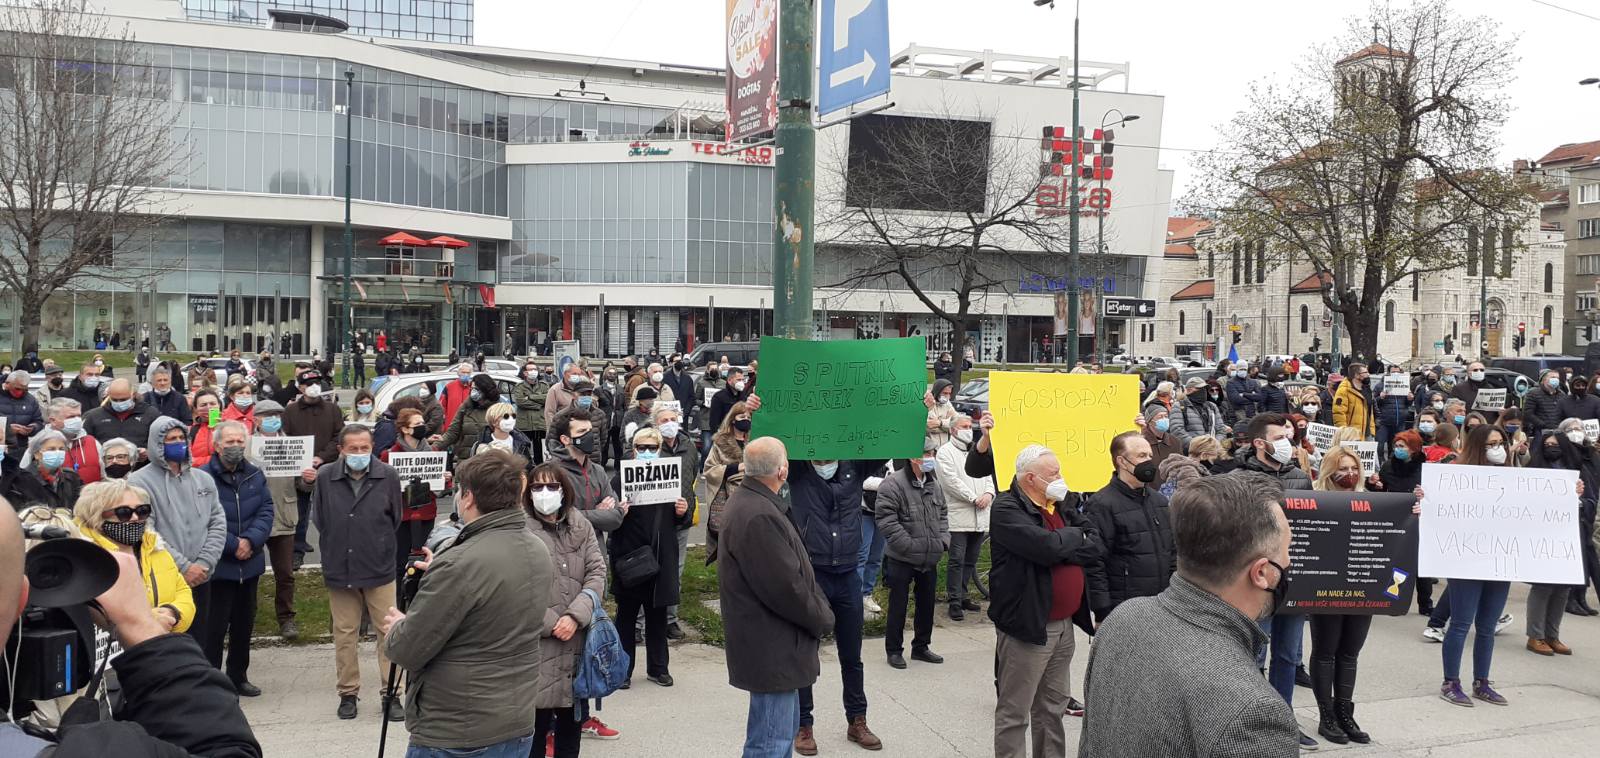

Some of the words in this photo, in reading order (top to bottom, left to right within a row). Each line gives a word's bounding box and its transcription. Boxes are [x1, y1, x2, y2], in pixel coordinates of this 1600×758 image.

[735, 30, 761, 62] SALE
[737, 79, 761, 99] DOĞTAŞ
[793, 359, 897, 387] SPUTNIK
[756, 387, 854, 412] MUBAREK
[865, 381, 927, 406] OLSUN
[392, 457, 413, 466] IDITE
[415, 456, 443, 466] ODMAH
[624, 462, 679, 484] DRŽAVA
[624, 484, 633, 492] NA
[634, 483, 656, 492] PRVOM
[657, 481, 679, 489] MJESTO
[1285, 498, 1318, 511] NEMA
[1350, 500, 1371, 513] IMA
[1437, 502, 1483, 519] BAHRU
[1492, 504, 1534, 521] KOJA
[1543, 509, 1571, 523] NAM
[1435, 530, 1520, 557] VAKCINA
